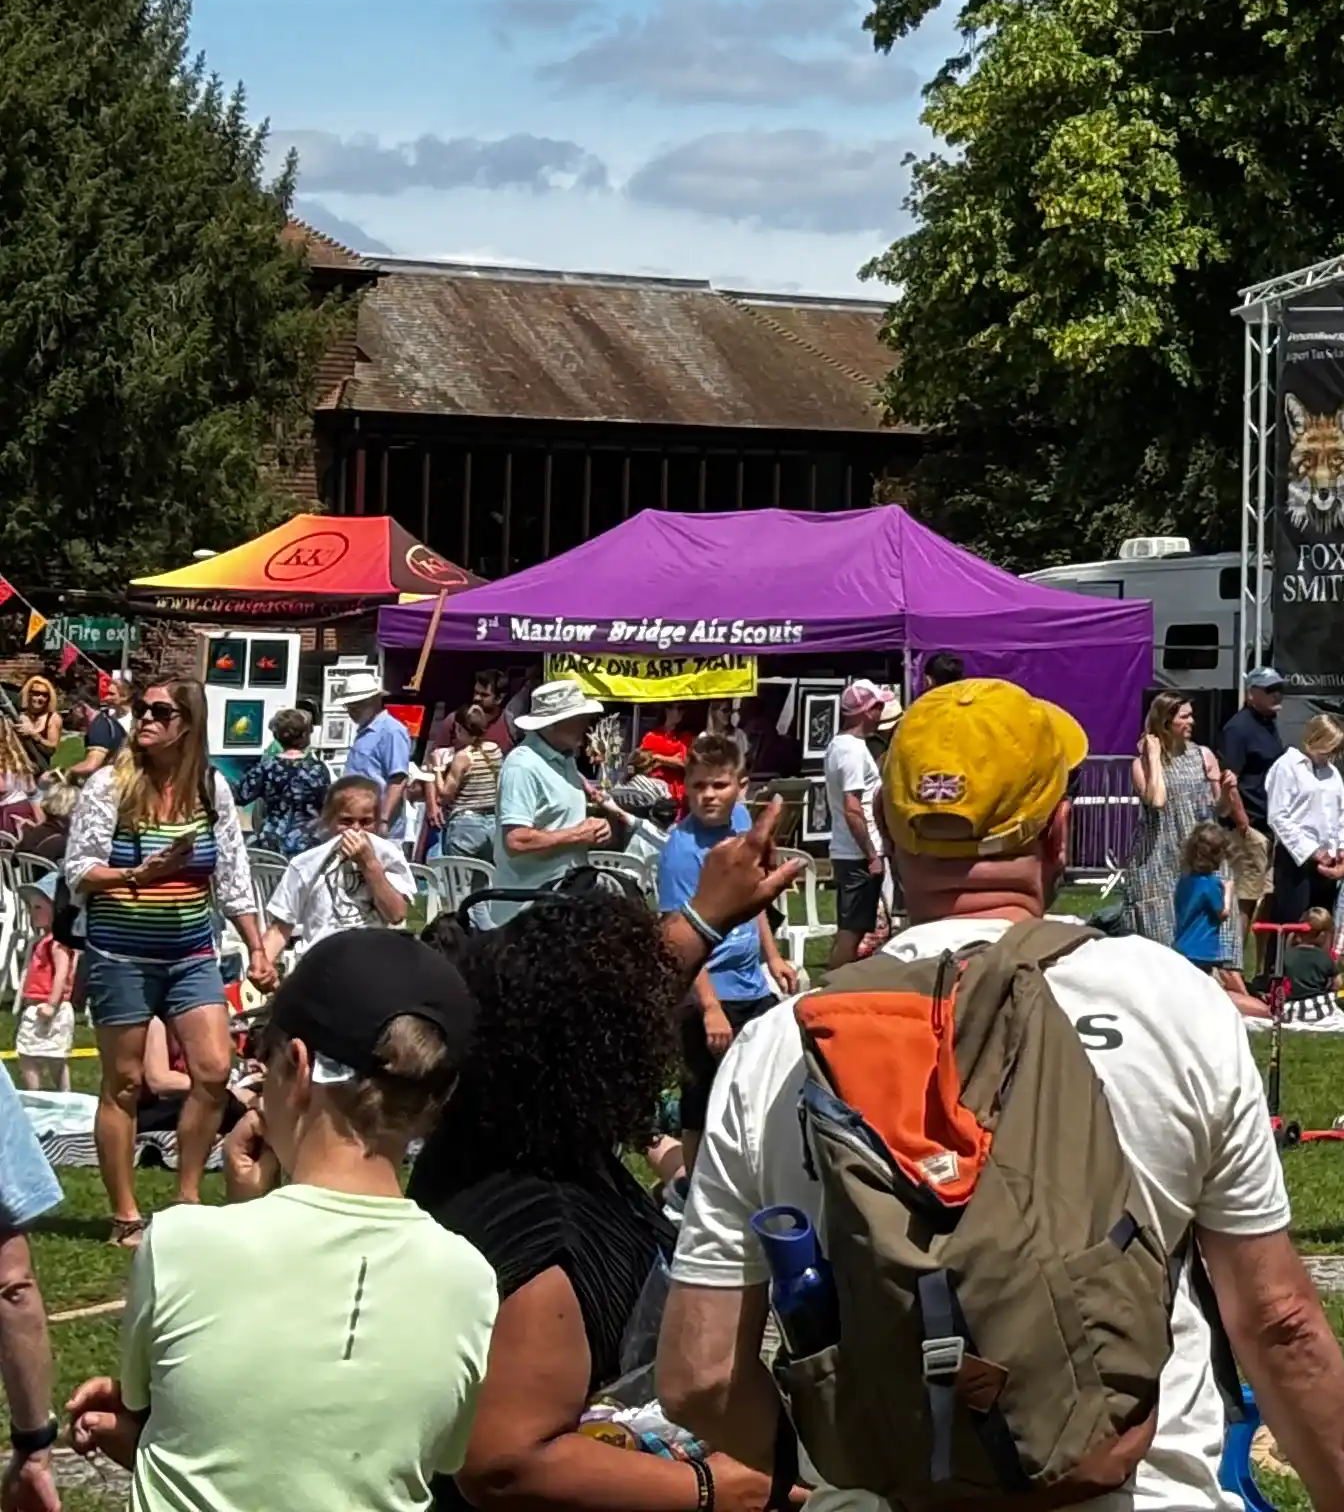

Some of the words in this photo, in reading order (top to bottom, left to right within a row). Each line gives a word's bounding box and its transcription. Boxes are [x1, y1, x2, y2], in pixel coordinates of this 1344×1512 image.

[68, 623, 101, 641] Fire
[105, 624, 138, 642] exit
[510, 616, 597, 642] Marlow
[607, 617, 687, 650] Bridge
[689, 618, 728, 643] Air
[729, 619, 804, 644] Scouts
[550, 653, 640, 677] MARLOW
[646, 657, 688, 678] ART
